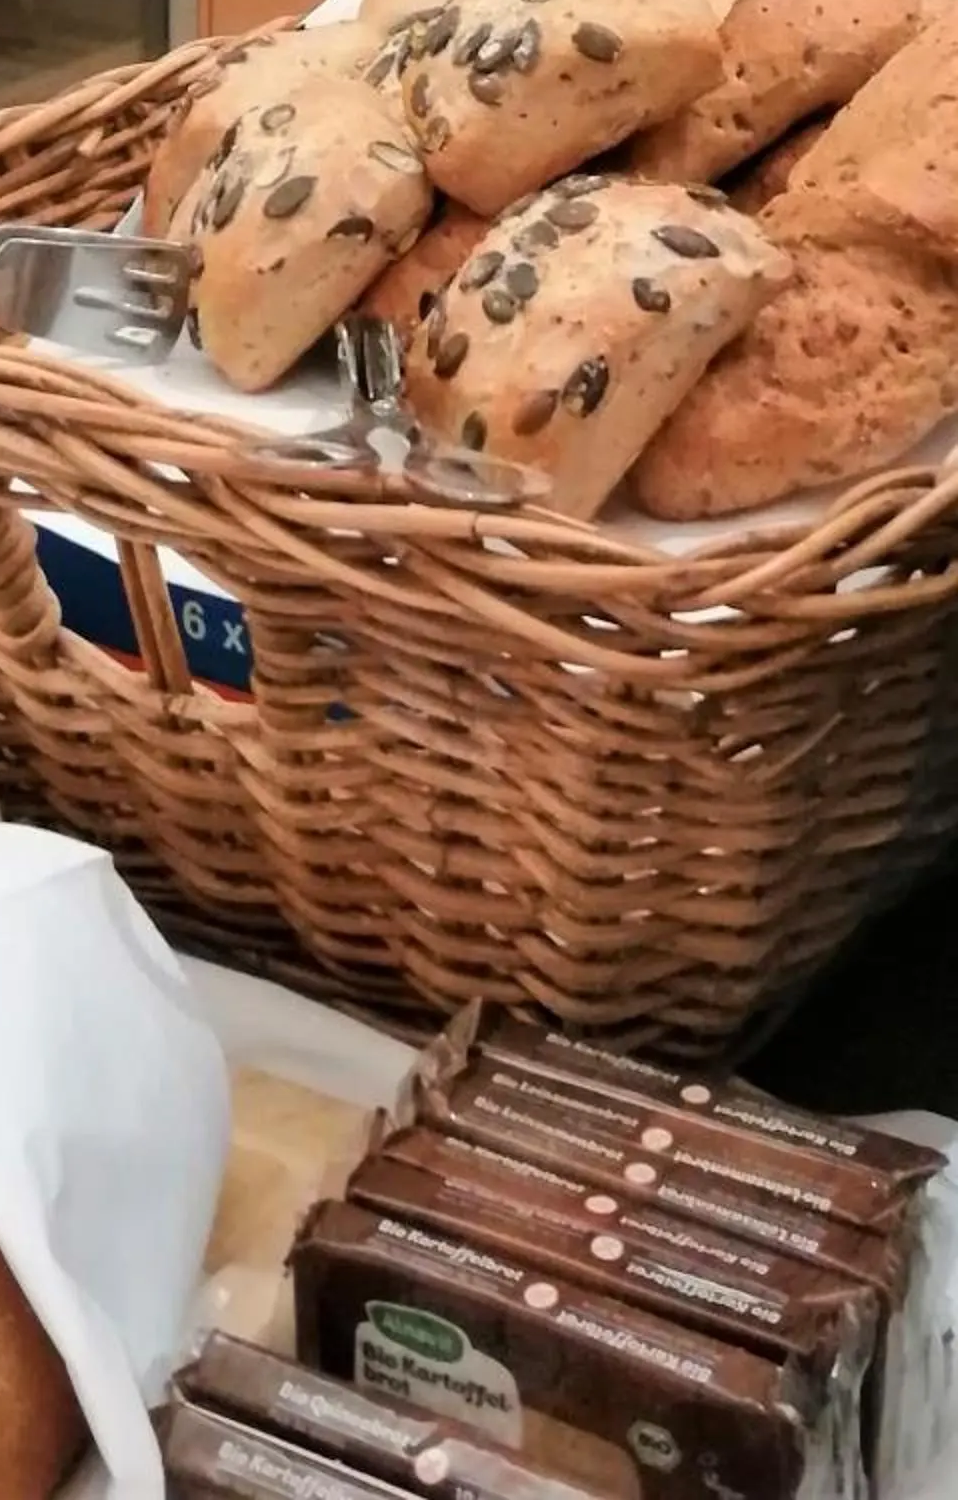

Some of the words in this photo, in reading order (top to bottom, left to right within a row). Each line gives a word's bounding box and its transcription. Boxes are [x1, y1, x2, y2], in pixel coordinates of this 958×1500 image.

[181, 601, 207, 641] 6
[222, 620, 246, 654] x
[378, 1219, 407, 1239] Bio
[407, 1229, 524, 1282] Kartoffelbrot
[363, 1341, 399, 1370] Bio
[278, 1380, 310, 1405] Bio
[363, 1363, 410, 1396] brot
[218, 1440, 249, 1467] Bio
